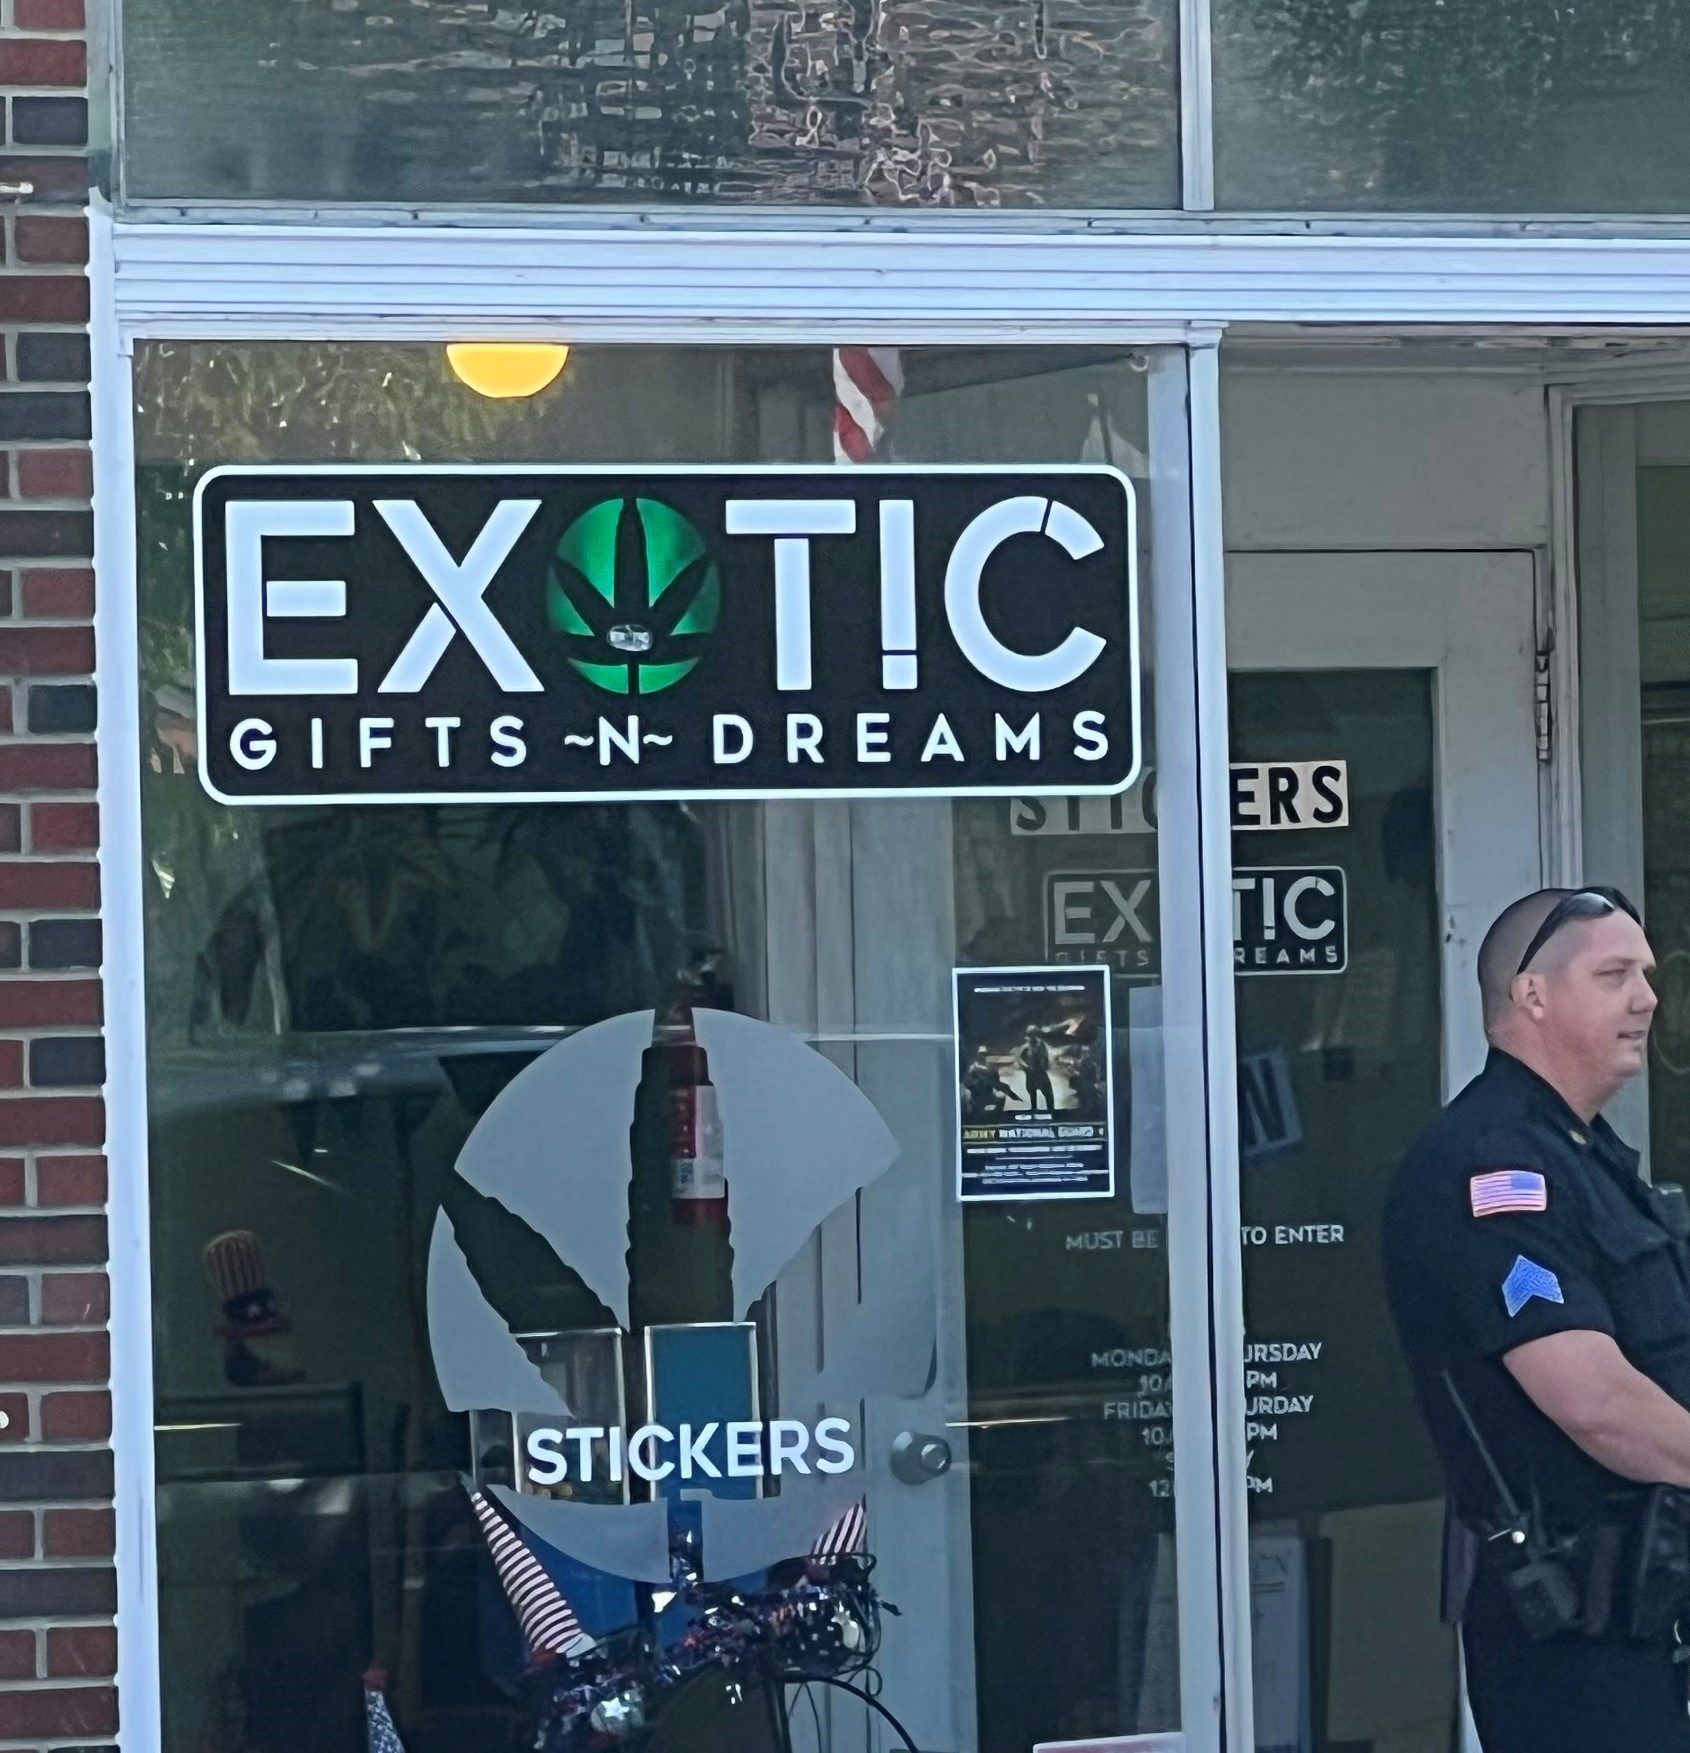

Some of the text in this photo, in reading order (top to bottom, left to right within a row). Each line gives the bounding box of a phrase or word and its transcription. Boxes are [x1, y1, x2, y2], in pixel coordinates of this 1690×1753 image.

[230, 713, 527, 769] GIFTS
[713, 710, 1108, 764] DREAMS
[1234, 946, 1338, 964] REAMS
[1066, 1224, 1344, 1249] MUST BE TO ENTER
[1091, 1348, 1171, 1367] MONDA
[526, 1417, 856, 1486] STICKERS
